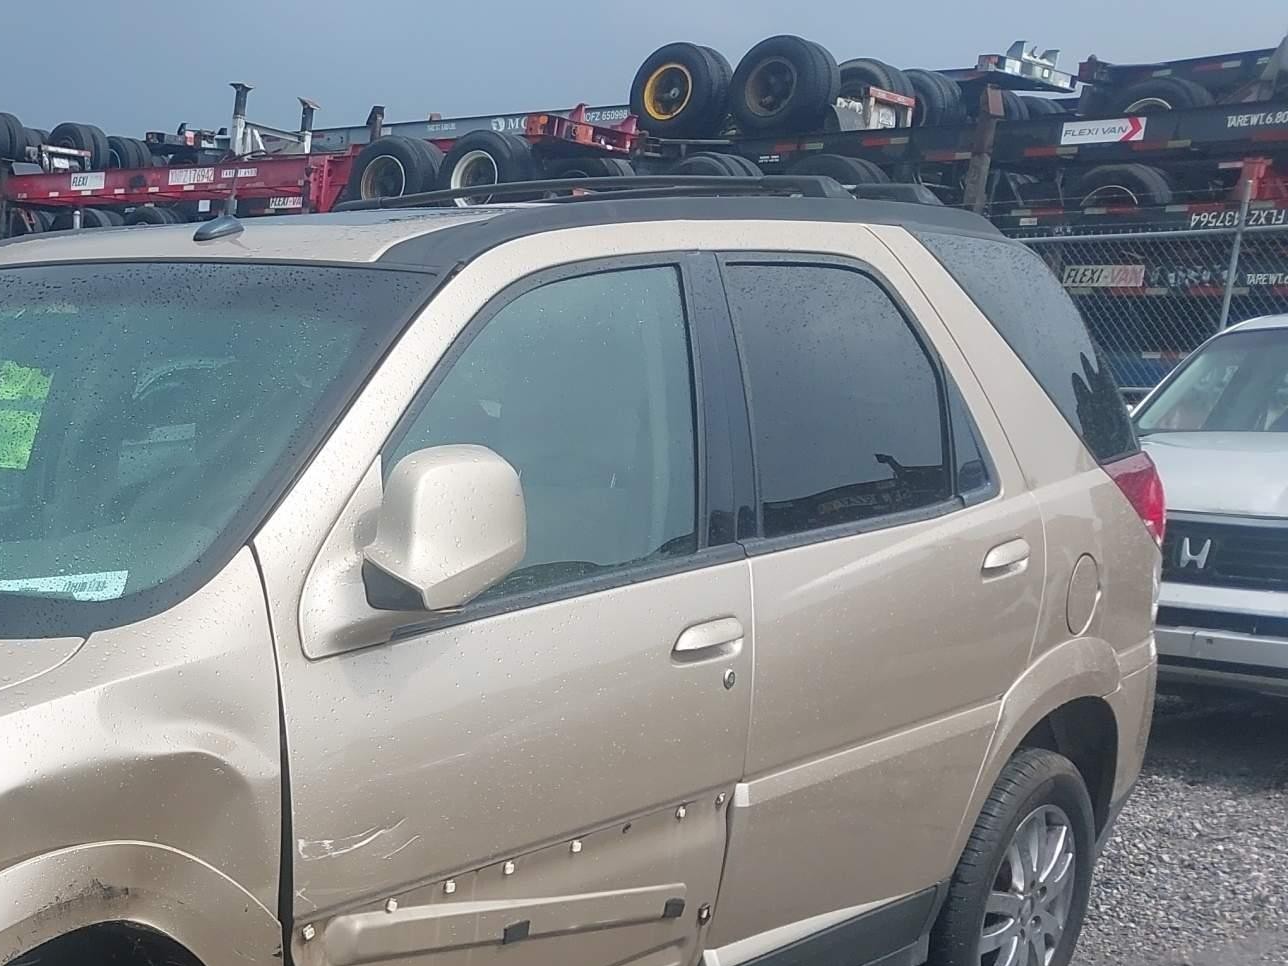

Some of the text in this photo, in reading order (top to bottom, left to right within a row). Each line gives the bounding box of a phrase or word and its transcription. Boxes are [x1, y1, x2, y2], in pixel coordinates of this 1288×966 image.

[1063, 126, 1128, 137] FLEXI VAN
[1190, 209, 1286, 228] FLXZ 137564
